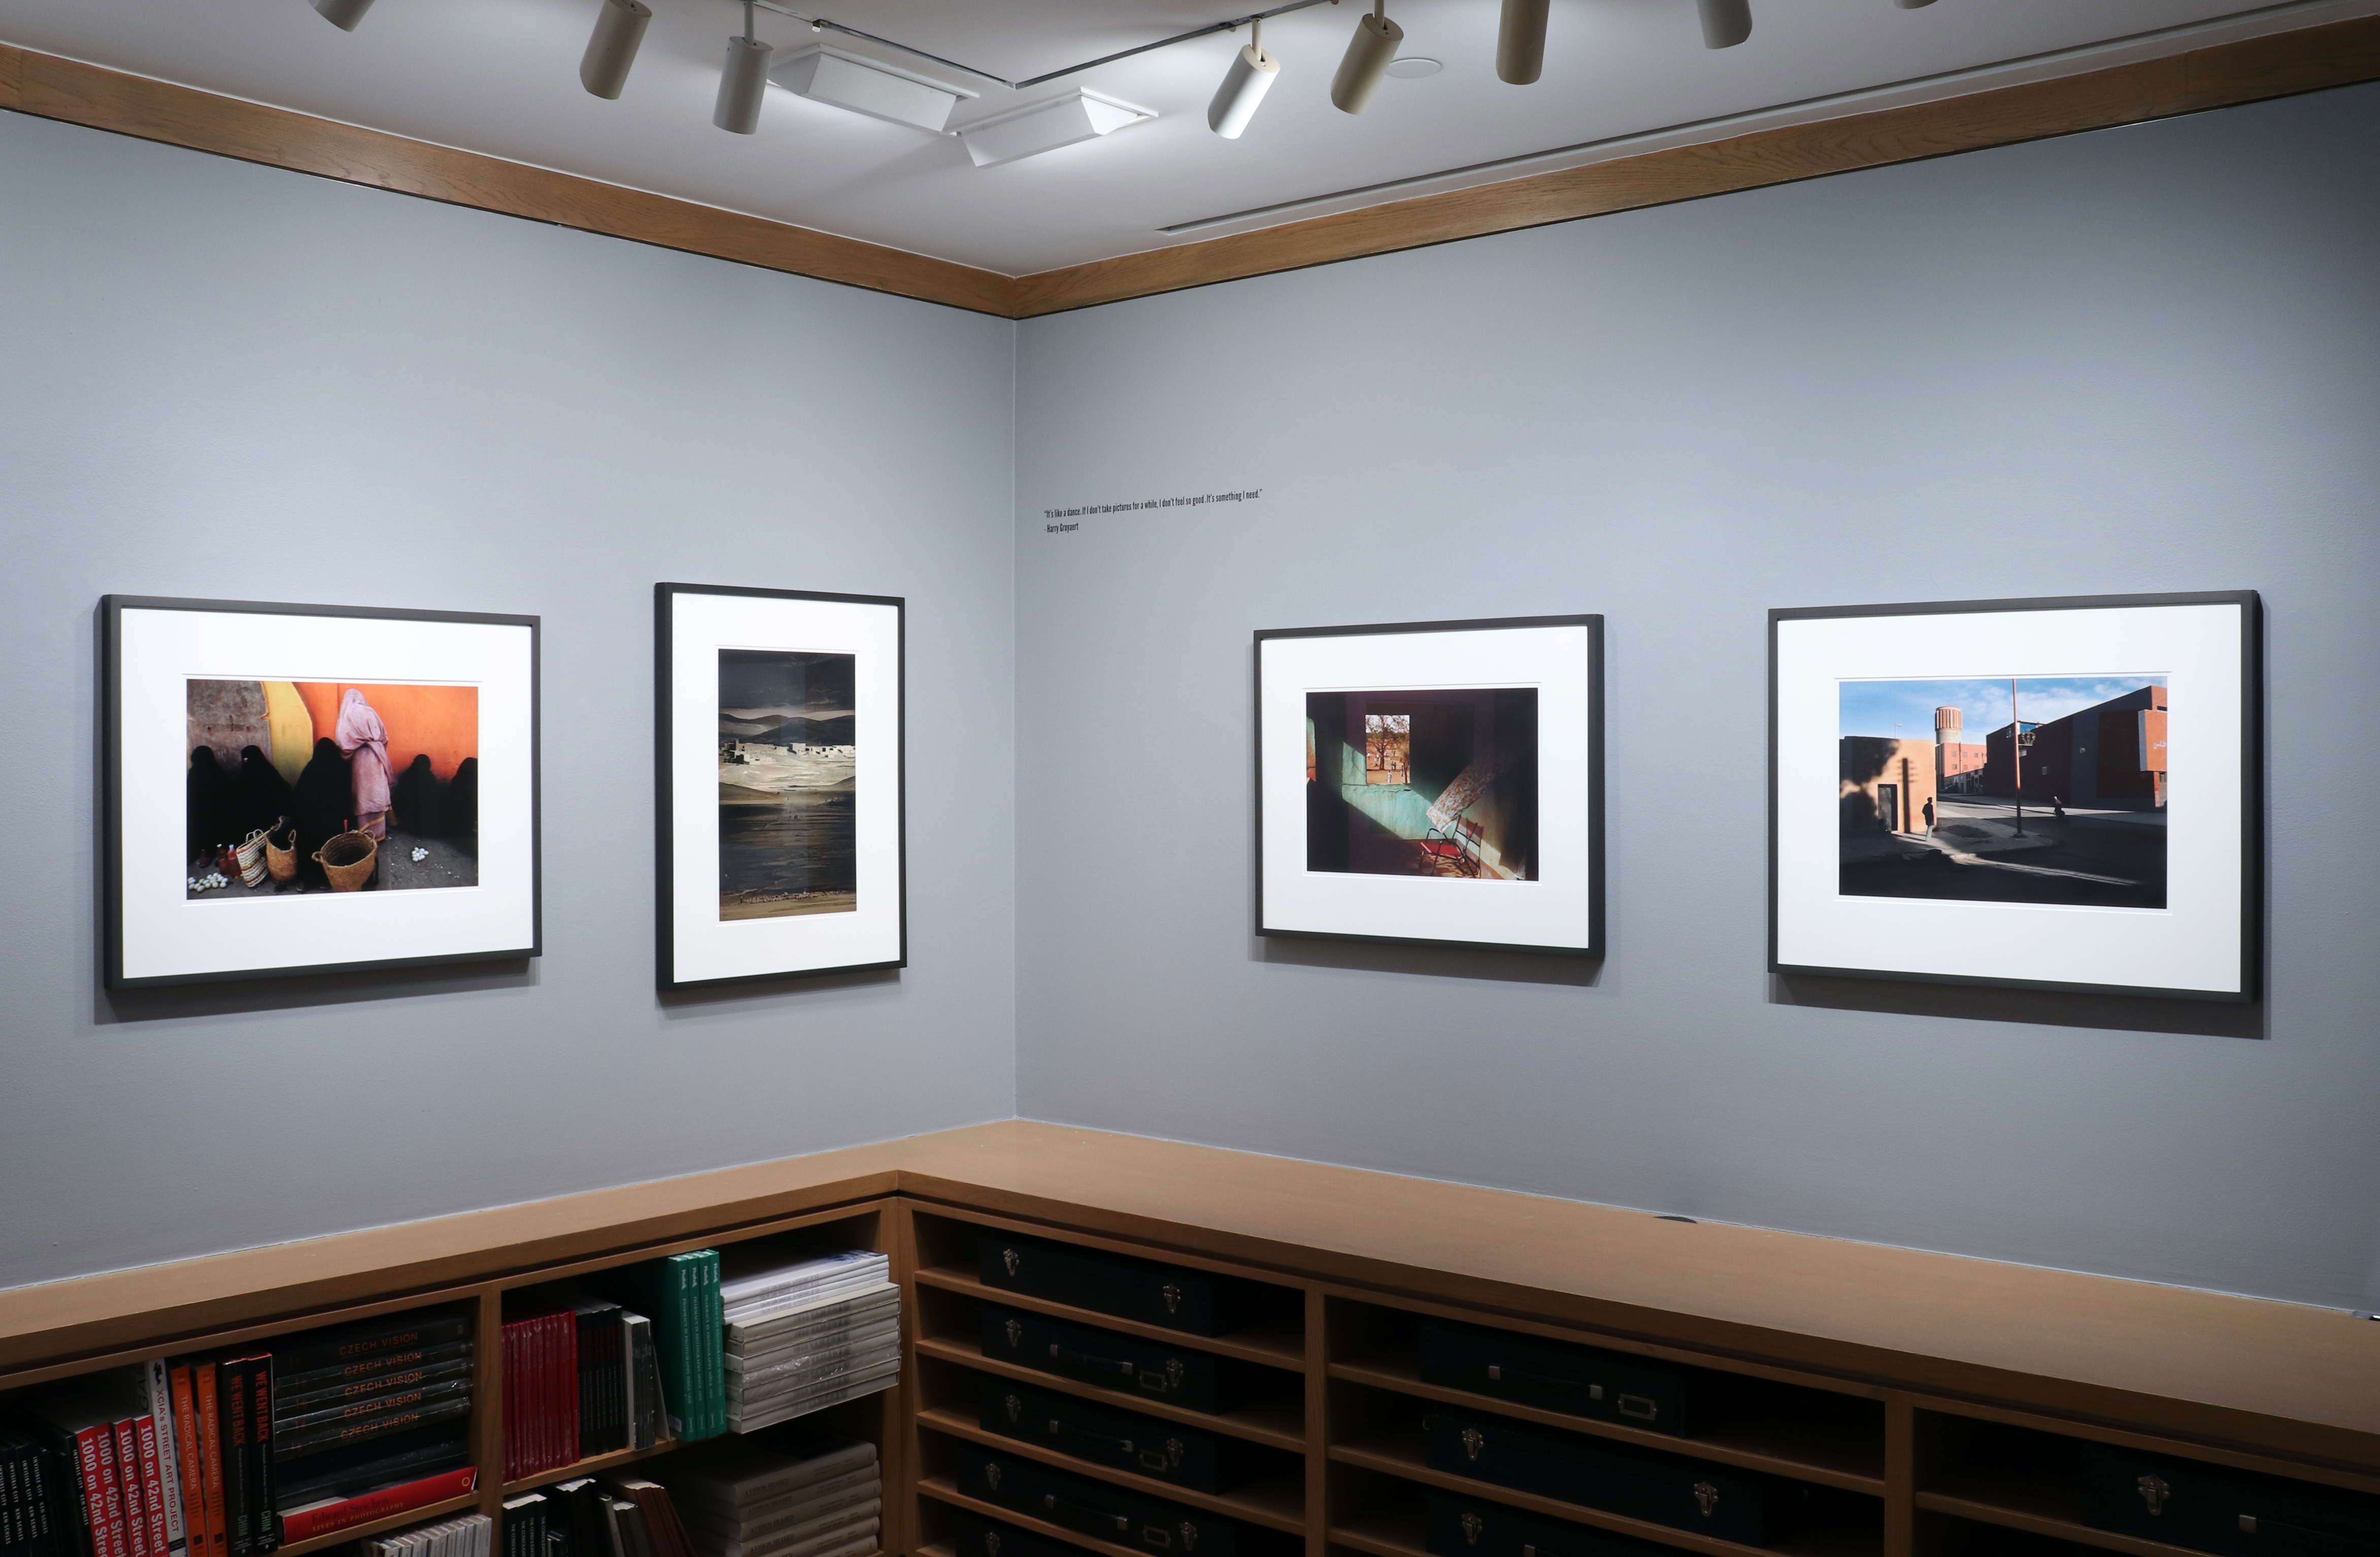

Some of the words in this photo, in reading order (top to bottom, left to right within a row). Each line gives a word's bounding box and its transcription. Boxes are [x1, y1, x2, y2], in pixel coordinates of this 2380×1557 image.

[1054, 509, 1062, 517] like
[1067, 508, 1082, 516] dance.
[1082, 507, 1086, 515] If
[1087, 507, 1089, 515] I
[1090, 505, 1101, 514] don't
[1102, 504, 1112, 513] take
[1113, 503, 1131, 514] pictures
[1144, 500, 1158, 509] while,
[1159, 499, 1161, 508] I
[1162, 498, 1174, 507] don't
[1176, 496, 1185, 506] feel
[1216, 491, 1242, 502] something
[1243, 490, 1245, 500] I
[1047, 524, 1059, 534] Harry
[1060, 522, 1079, 533] Gruyaert
[340, 1341, 378, 1355] CZECH
[382, 1332, 418, 1347] VISION
[344, 1361, 382, 1376] CZECH
[386, 1352, 422, 1367] VISION
[230, 1375, 243, 1392] WE
[255, 1371, 267, 1388] WE
[345, 1381, 382, 1397] CZECH
[386, 1371, 423, 1386] VISION
[181, 1395, 189, 1412] THE
[232, 1391, 244, 1418] WENT
[256, 1387, 269, 1414] WENT
[344, 1402, 382, 1418] CZECH
[385, 1393, 421, 1407] VISION
[183, 1413, 194, 1451] RADICAL
[207, 1412, 217, 1450] RADICAL
[233, 1419, 245, 1447] BACK
[257, 1415, 269, 1443] BACK
[341, 1423, 378, 1439] CZECH
[382, 1413, 419, 1429] VISION
[81, 1438, 97, 1472] 1000
[97, 1432, 113, 1466] 1000
[120, 1429, 135, 1463] 1000
[141, 1425, 155, 1459] 1000
[160, 1424, 171, 1461] STREET
[9, 1462, 17, 1490] INVISIBLE
[22, 1460, 30, 1487] INVISIBLE
[32, 1456, 41, 1483] INVISIBLE
[73, 1449, 82, 1476] INVISIBLE
[103, 1468, 112, 1484] on
[124, 1465, 135, 1481] on
[145, 1462, 155, 1478] on
[164, 1465, 174, 1484] ART
[186, 1452, 197, 1490] CAMERA
[209, 1451, 219, 1488] CAMERA
[87, 1474, 97, 1491] on
[147, 1480, 161, 1512] 42nd
[90, 1493, 106, 1526] 42nd
[106, 1486, 121, 1518] 42nd
[127, 1484, 142, 1516] 42nd
[168, 1487, 179, 1532] PROJECT
[312, 1506, 348, 1524] Edward
[349, 1497, 389, 1512] Steichen
[238, 1514, 248, 1537] CHIM
[261, 1510, 272, 1532] CHIM
[312, 1521, 334, 1532] LIVES
[350, 1502, 404, 1521] PHOTOGRAPHY
[95, 1526, 108, 1557] Stre
[131, 1517, 147, 1557] Street
[151, 1513, 166, 1554] Street
